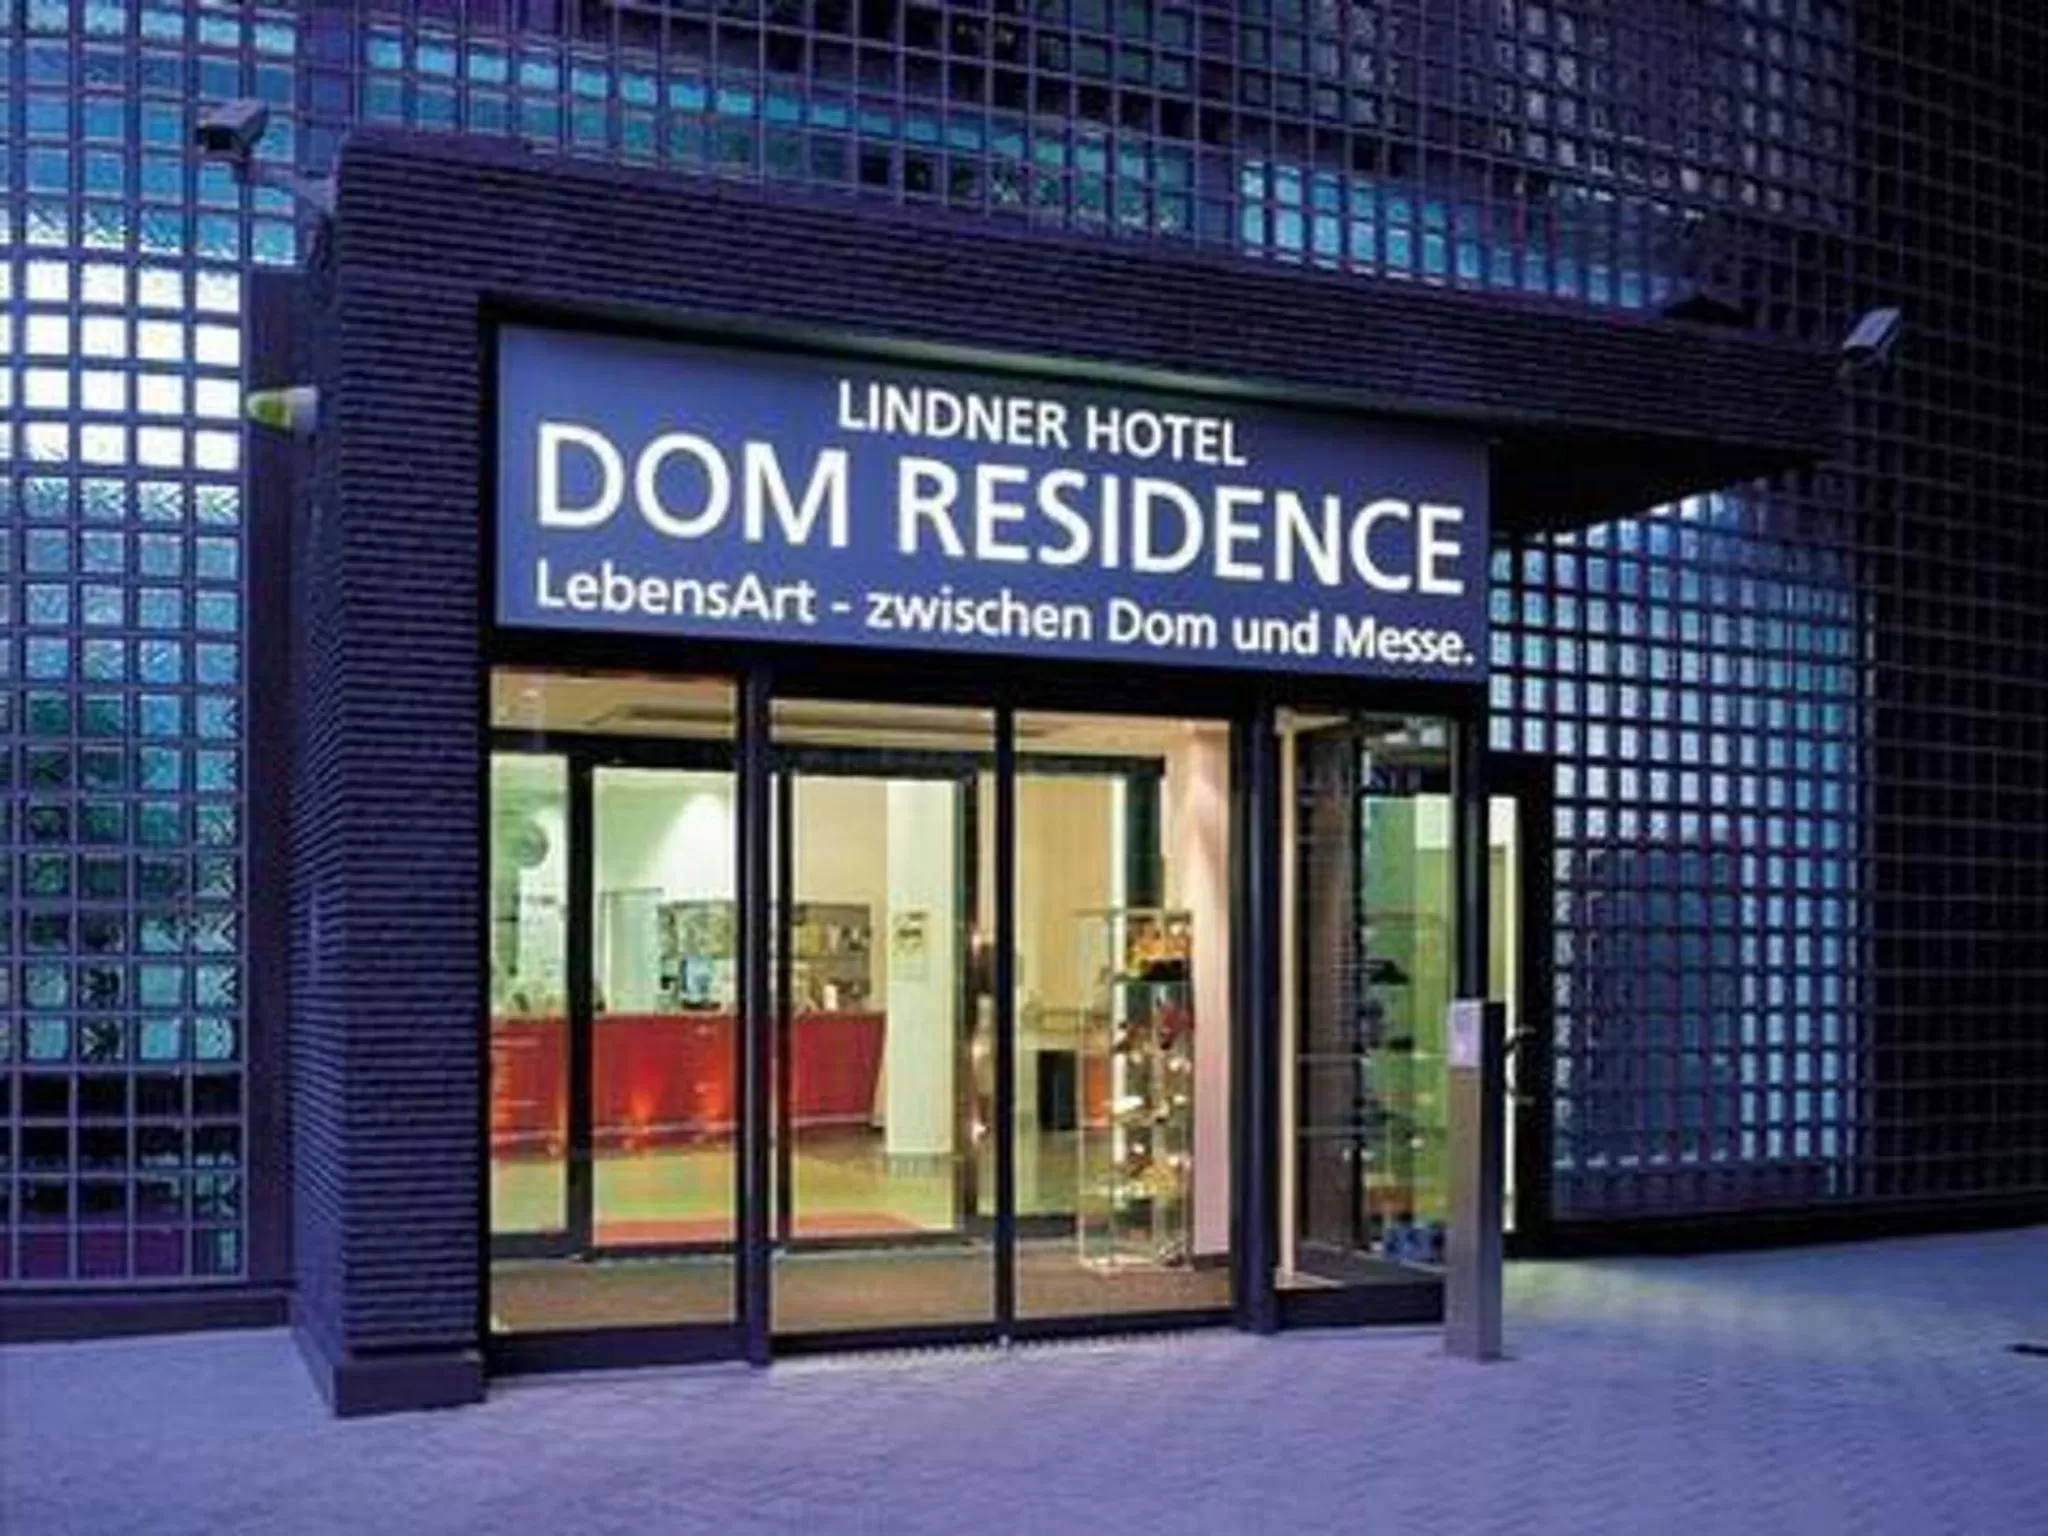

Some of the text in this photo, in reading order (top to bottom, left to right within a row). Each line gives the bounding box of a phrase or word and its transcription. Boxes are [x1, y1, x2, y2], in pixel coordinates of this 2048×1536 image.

[837, 379, 1248, 467] LINDNER HOTEL
[537, 421, 1465, 596] DOM RESIDENCE
[536, 557, 818, 625] LebensArt
[866, 586, 1091, 641] zwischen
[1107, 598, 1218, 650] Dom
[1232, 611, 1320, 655] und
[1333, 614, 1475, 666] Messe.
